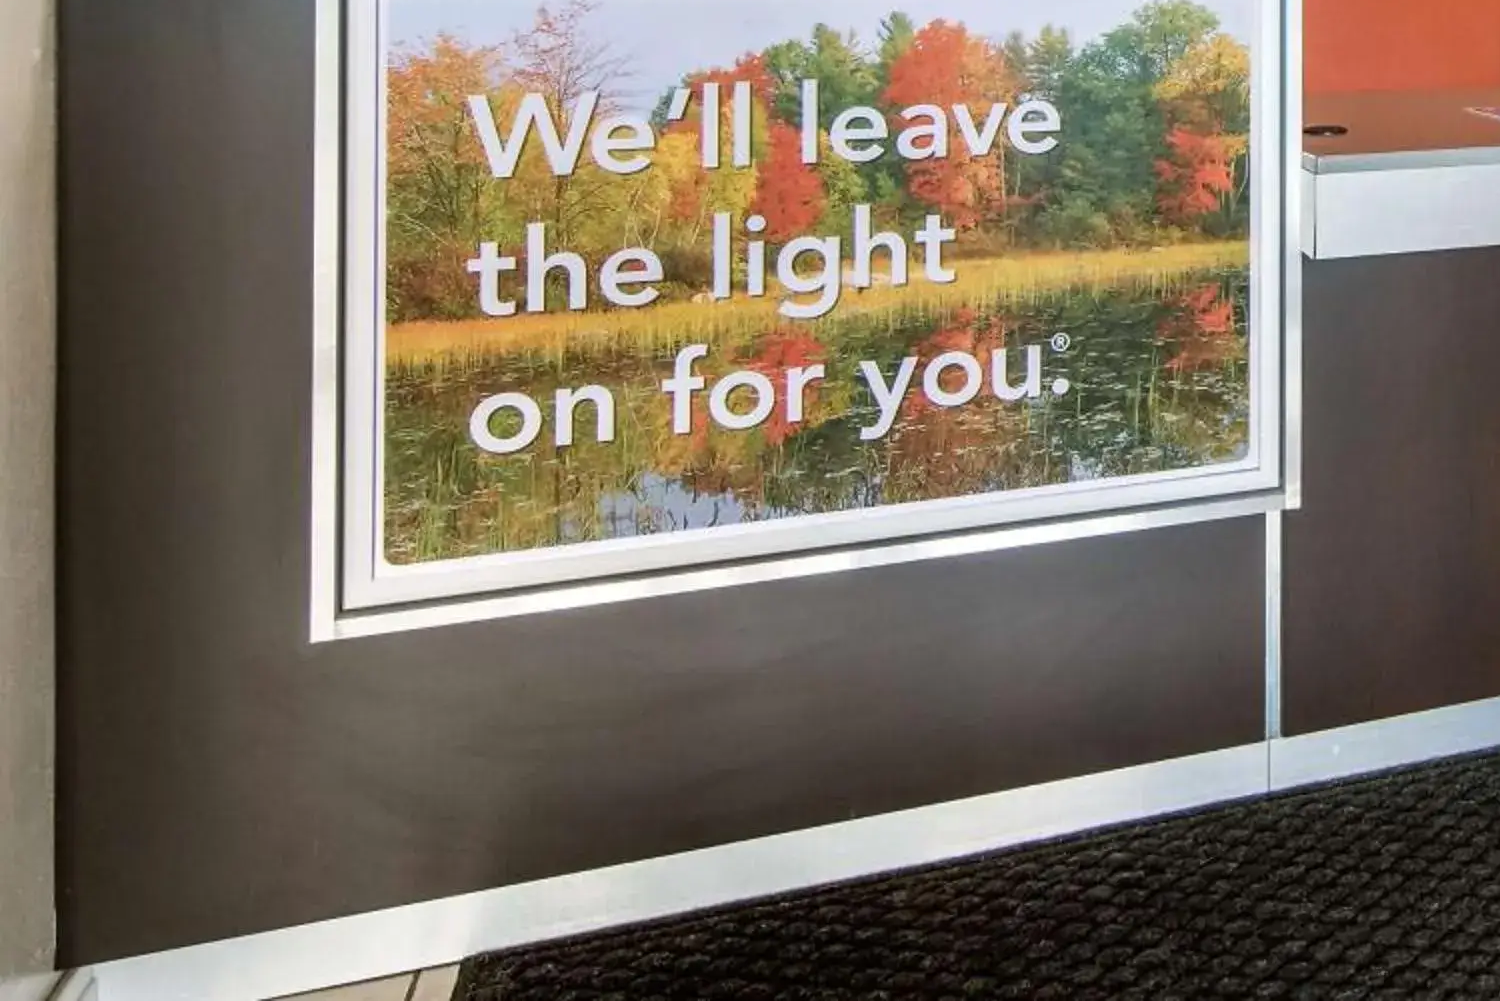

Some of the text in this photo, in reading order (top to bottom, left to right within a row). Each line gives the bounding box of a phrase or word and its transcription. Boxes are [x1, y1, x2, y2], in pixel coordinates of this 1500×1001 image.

[468, 78, 1062, 179] We'll leave
[466, 203, 957, 319] the light
[469, 383, 616, 455] on
[661, 343, 826, 435] for
